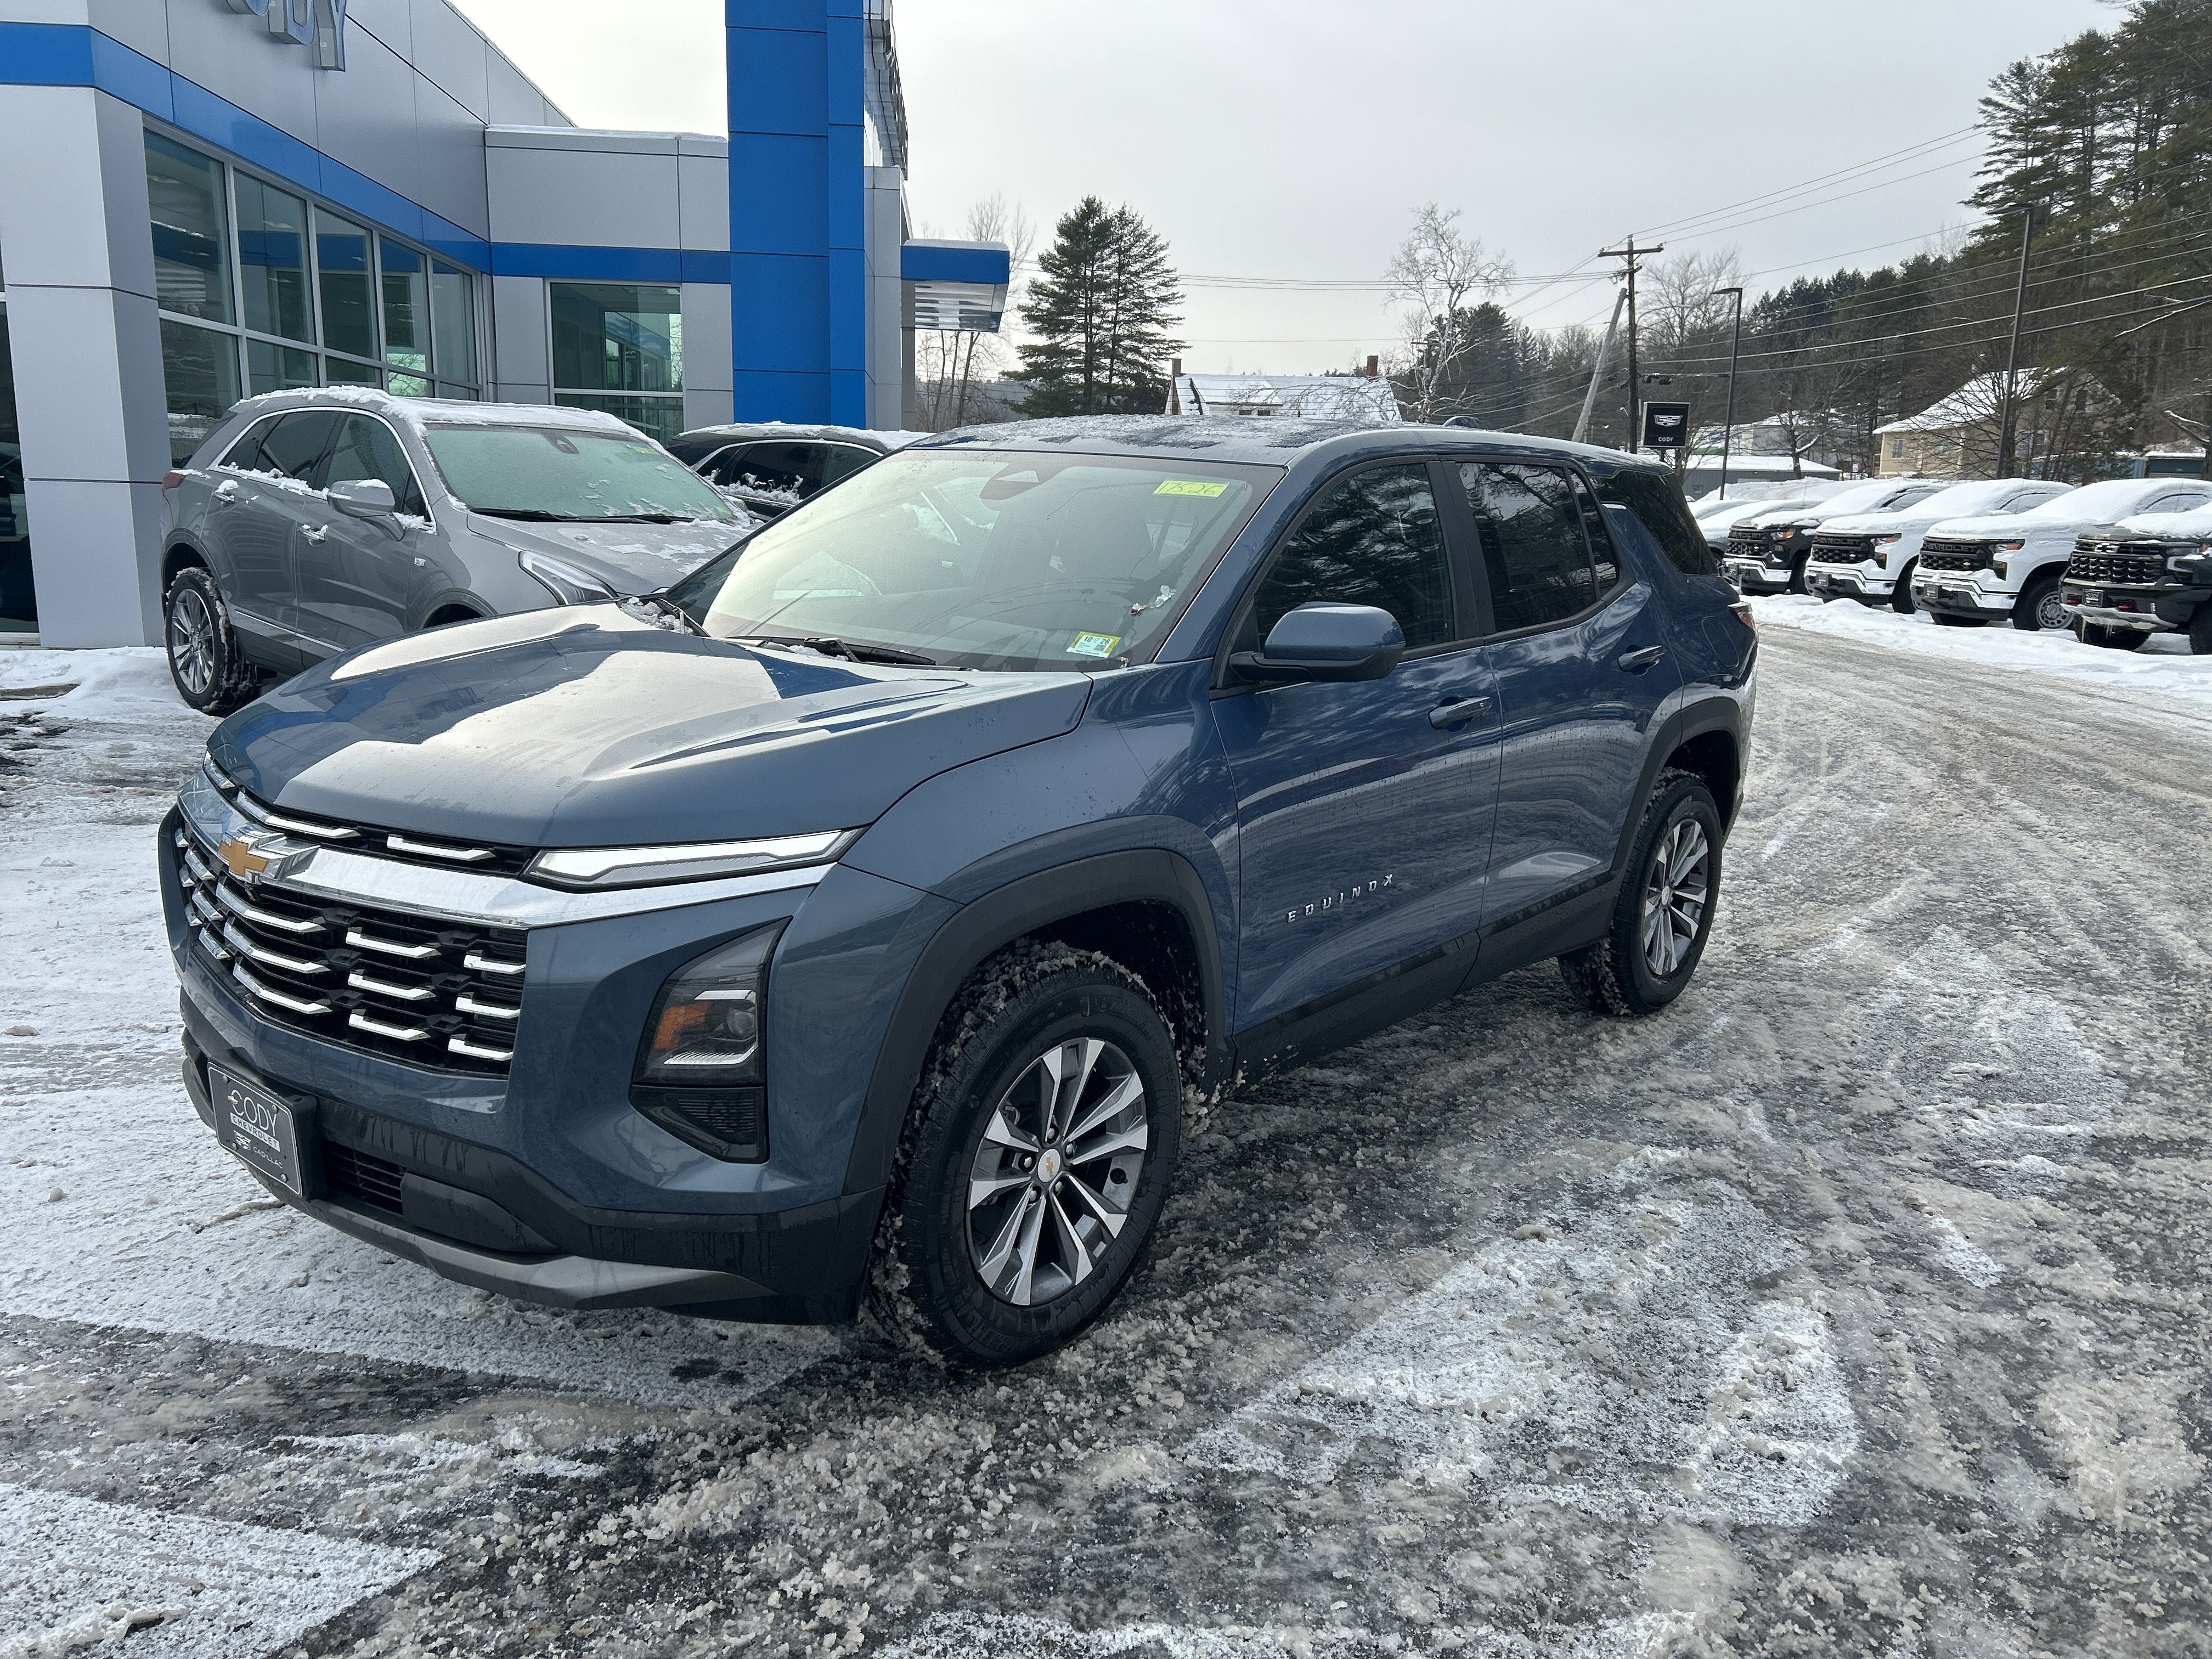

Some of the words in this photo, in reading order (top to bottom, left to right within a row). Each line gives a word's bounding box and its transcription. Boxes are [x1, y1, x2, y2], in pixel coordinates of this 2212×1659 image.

[1287, 873, 1393, 923] EQUINOX
[230, 1090, 277, 1137] CODY
[233, 1114, 279, 1148] CHEVROLET
[253, 1146, 283, 1169] CADILLAC
